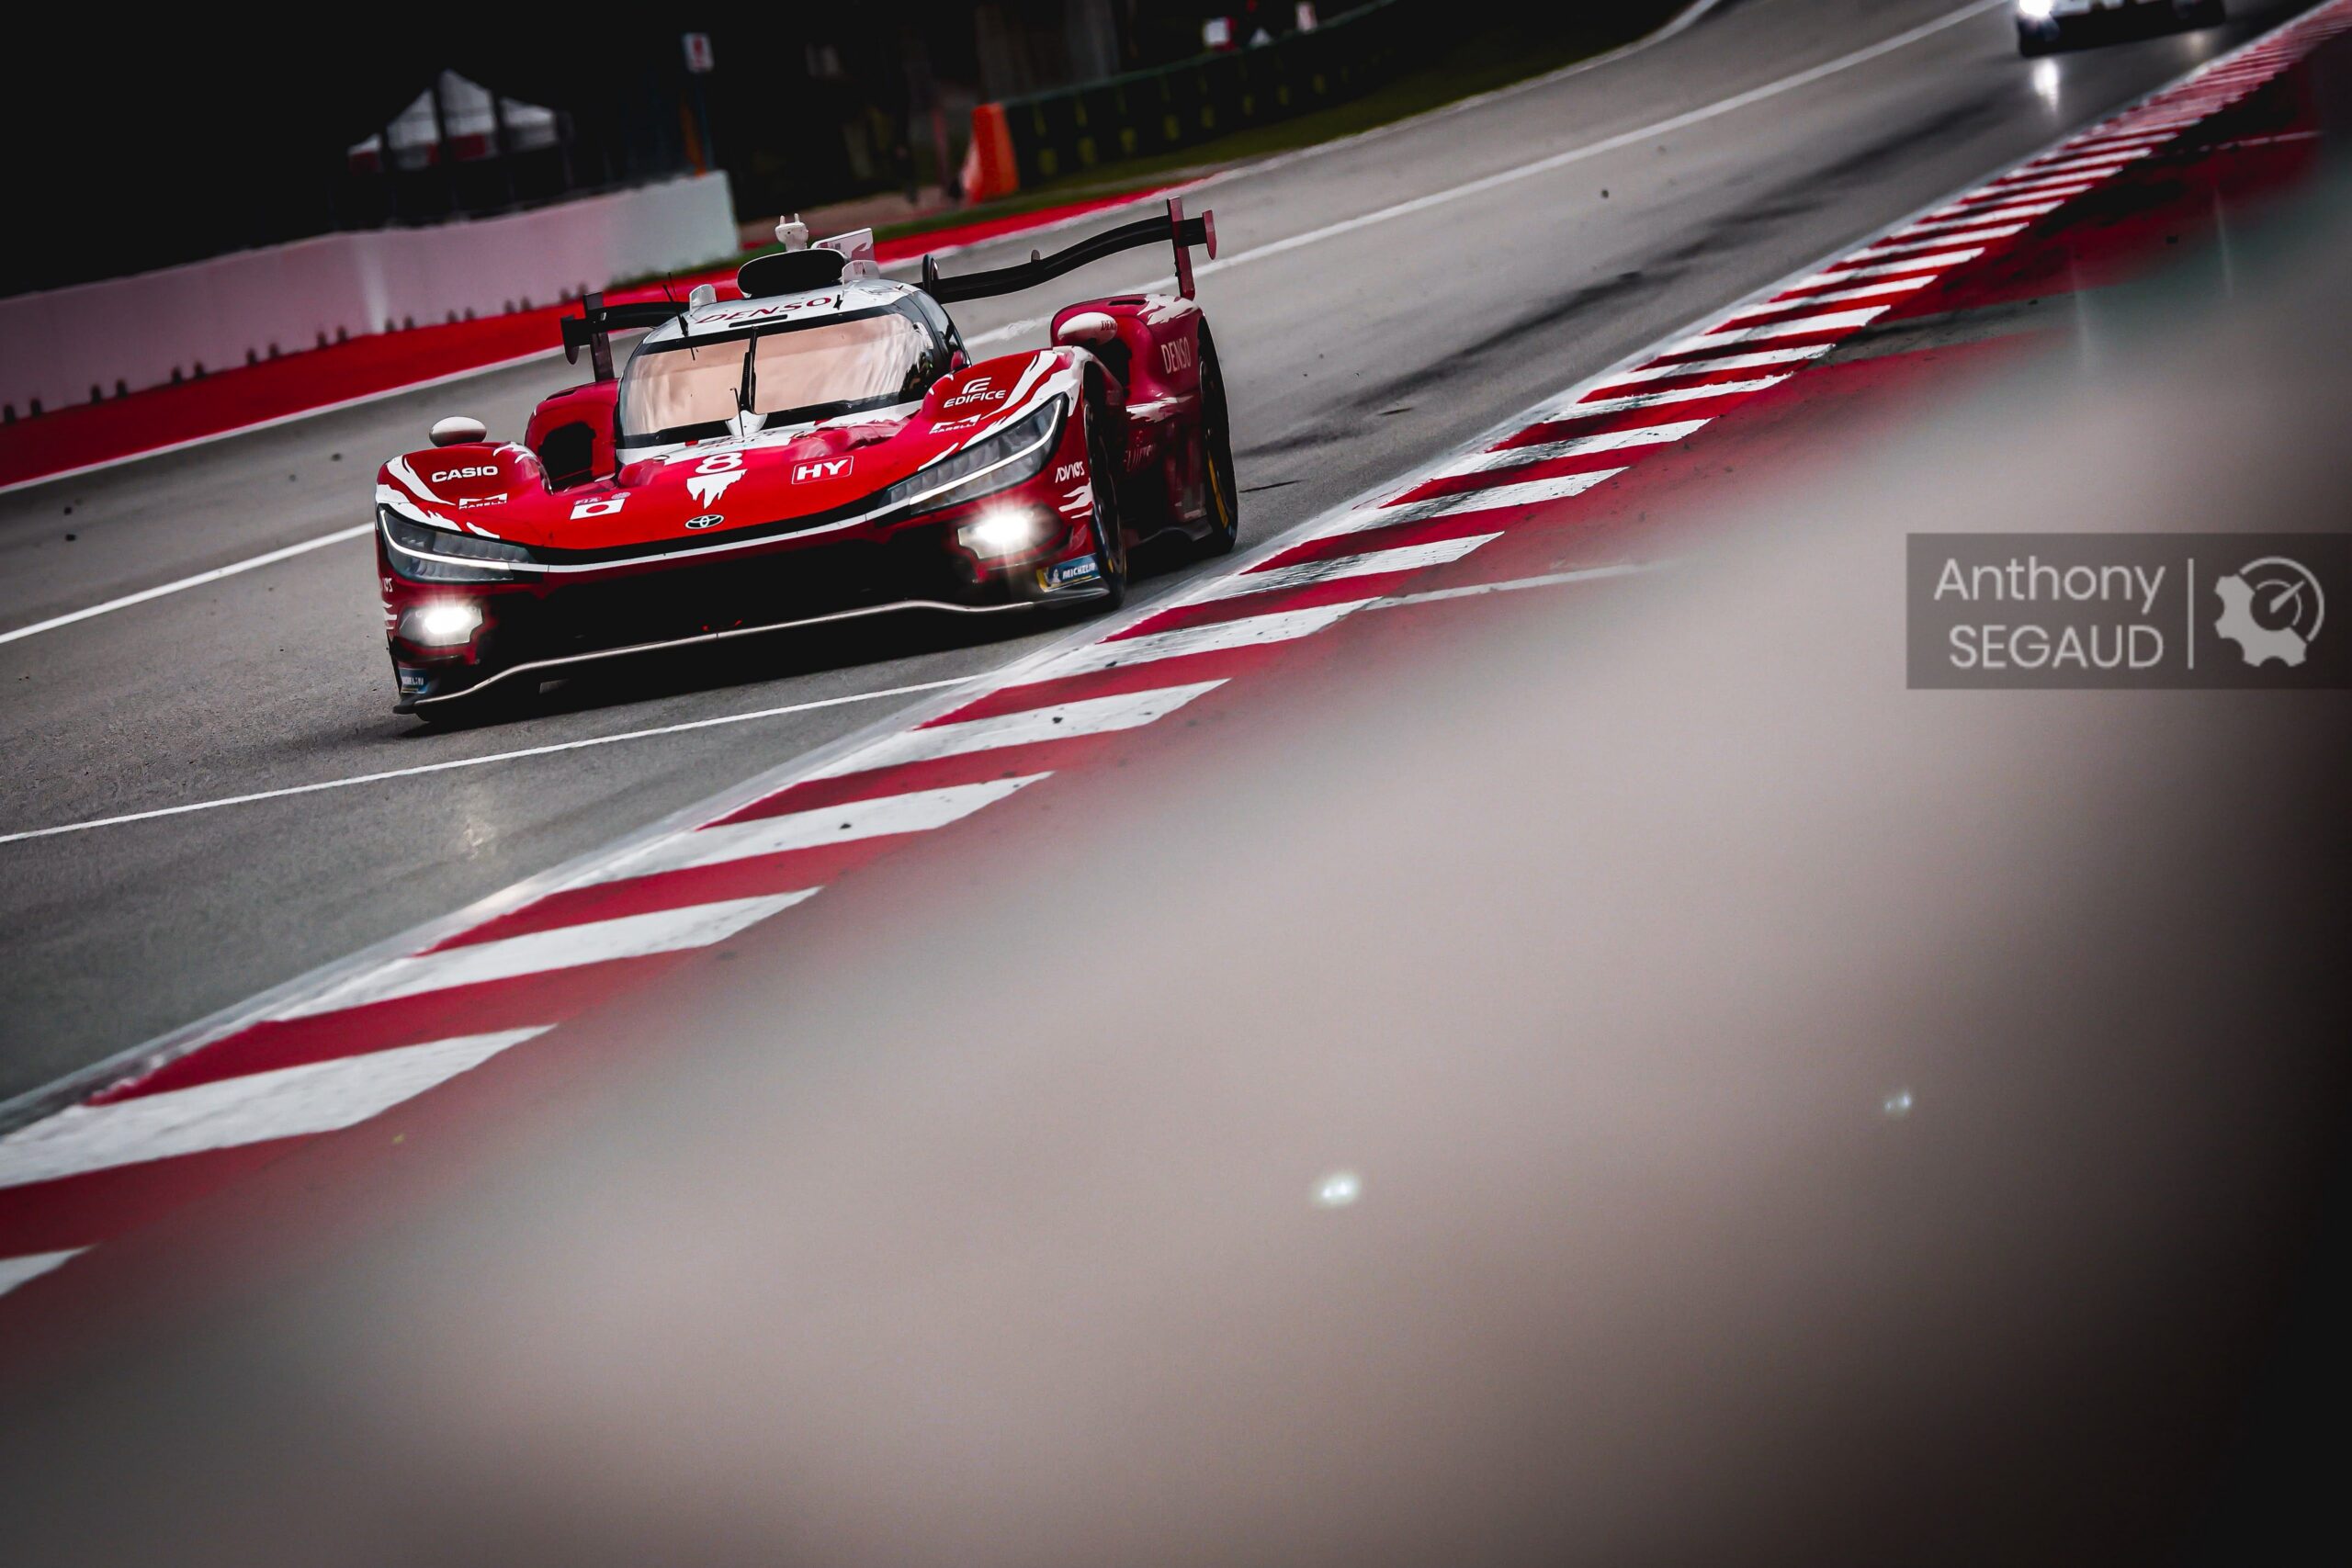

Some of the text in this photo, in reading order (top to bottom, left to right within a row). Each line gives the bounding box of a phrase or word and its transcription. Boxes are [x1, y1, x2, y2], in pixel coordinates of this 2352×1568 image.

[695, 297, 831, 324] DENSO
[1160, 336, 1192, 374] DENSO
[943, 389, 1007, 409] EDIFICE
[695, 452, 743, 474] 8
[797, 458, 849, 480] HY
[431, 466, 499, 483] CASIO
